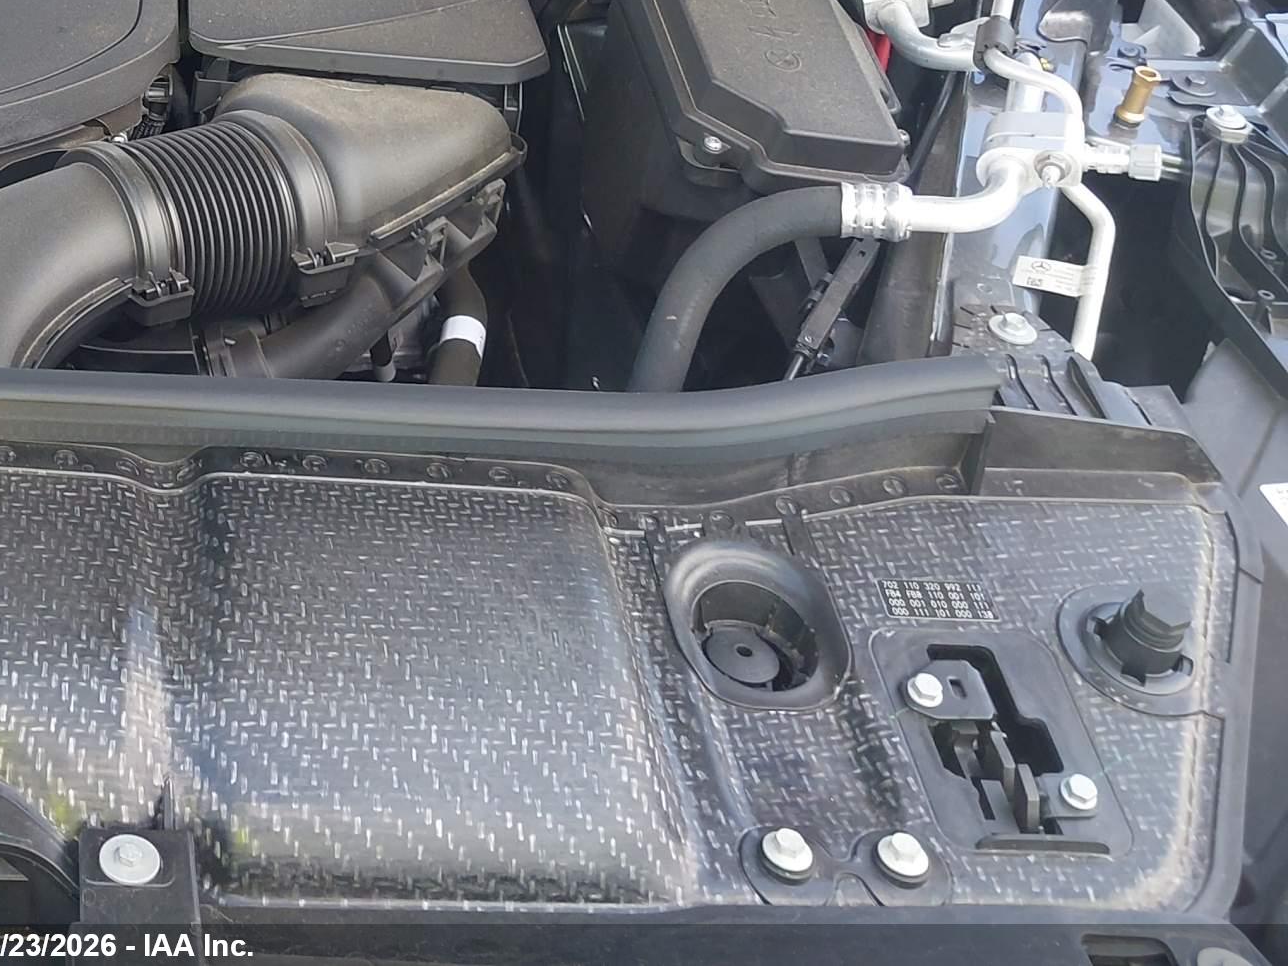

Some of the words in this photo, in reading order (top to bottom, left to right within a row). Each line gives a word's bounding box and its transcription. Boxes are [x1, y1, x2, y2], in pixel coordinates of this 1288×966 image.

[881, 580, 899, 589] 702
[903, 581, 920, 590] 110
[923, 582, 940, 591] 320
[966, 584, 981, 592] 111
[928, 591, 944, 600] 110
[948, 592, 964, 600] 001
[969, 592, 985, 601] 101
[888, 598, 906, 607] 000
[909, 599, 926, 608] 001
[930, 600, 947, 609] 010
[951, 600, 969, 609] 000
[973, 601, 989, 610] 111
[892, 607, 909, 616] 000
[913, 608, 929, 616] 111
[935, 609, 951, 618] 101
[955, 609, 973, 618] 000
